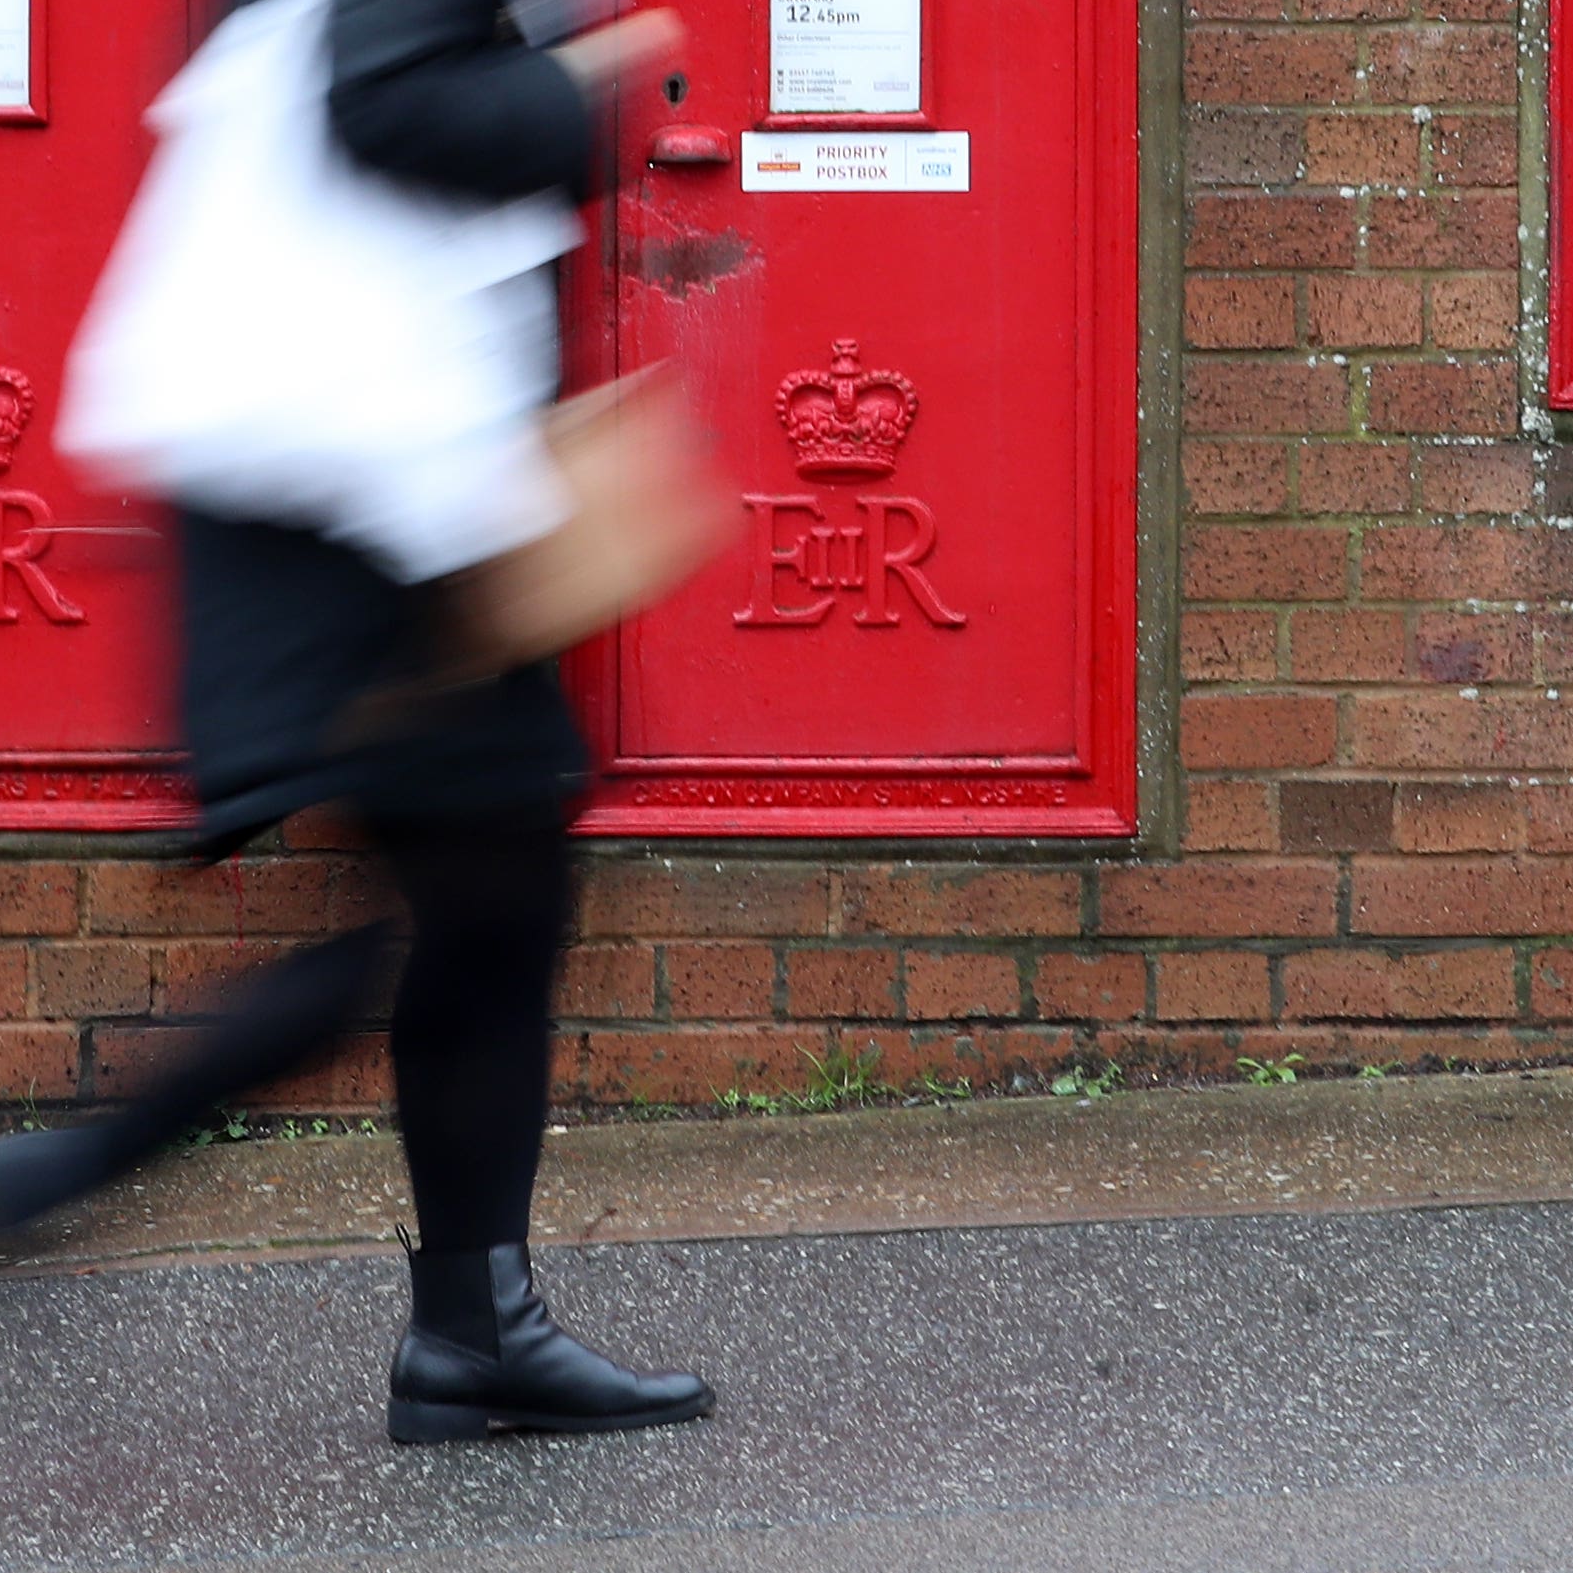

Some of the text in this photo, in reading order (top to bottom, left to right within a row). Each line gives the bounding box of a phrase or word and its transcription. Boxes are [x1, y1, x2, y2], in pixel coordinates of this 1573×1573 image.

[786, 5, 860, 25] 12.45pm
[816, 145, 888, 159] PRIORITY
[816, 165, 888, 180] POSTBOX
